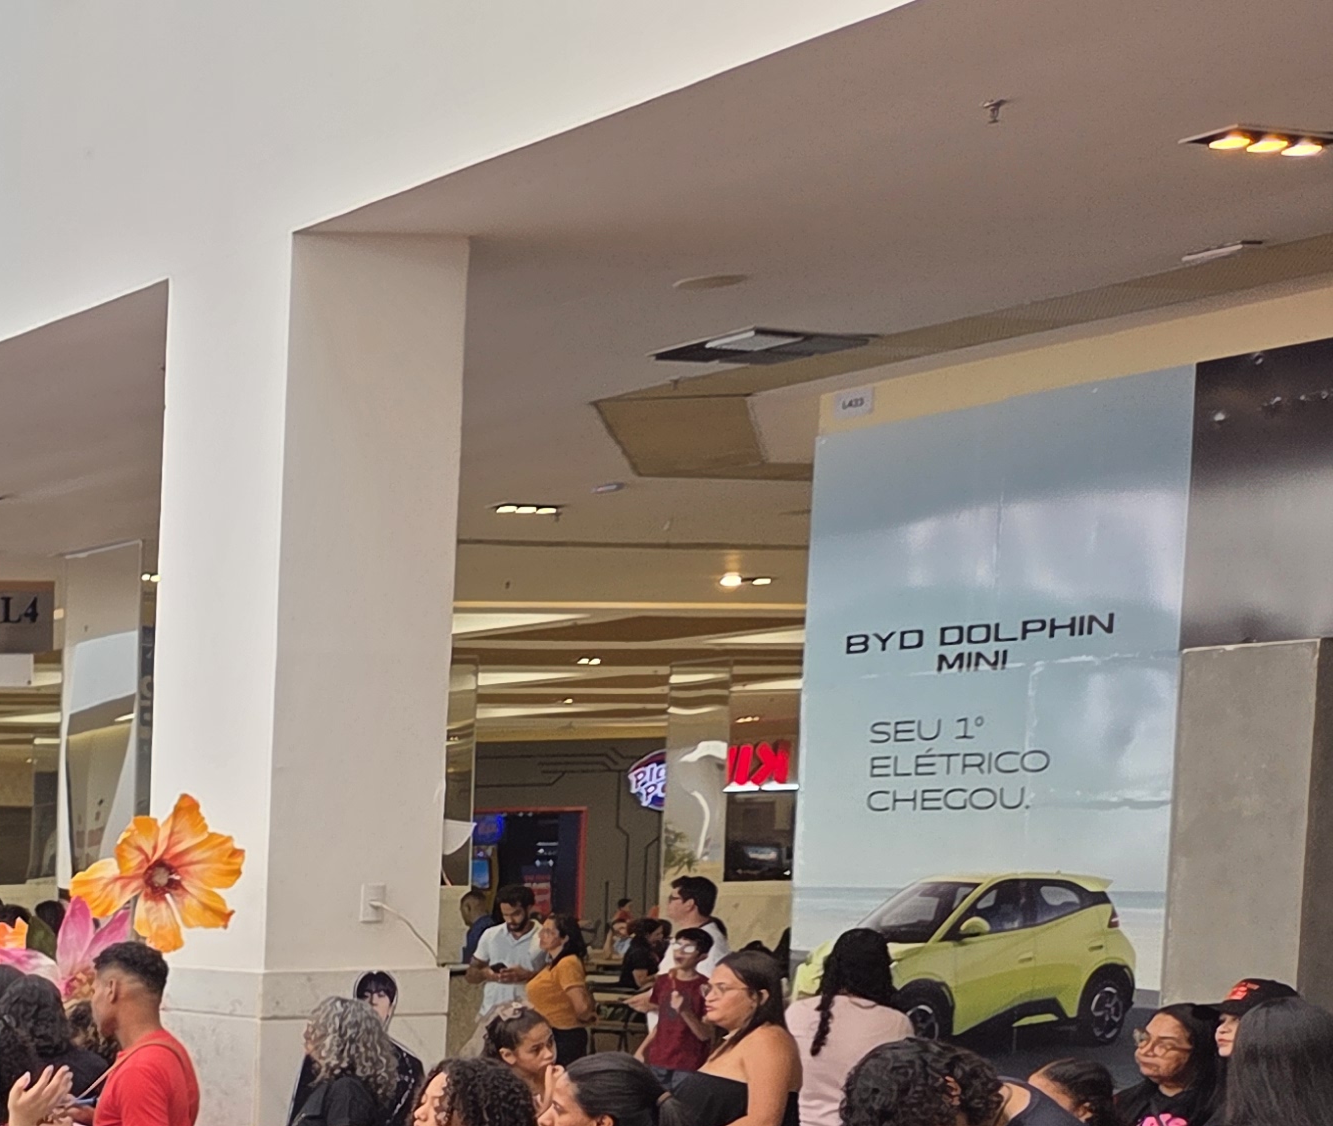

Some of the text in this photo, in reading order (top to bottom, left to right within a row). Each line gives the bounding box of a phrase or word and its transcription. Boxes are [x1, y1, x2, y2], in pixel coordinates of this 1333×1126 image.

[0, 596, 39, 624] L4
[845, 612, 1115, 654] BYD DOLPHIN
[936, 649, 1008, 673] MINI
[869, 719, 941, 744] SEU
[869, 747, 1050, 778] ELÉTRICO
[866, 786, 1031, 812] CHEGOU.
